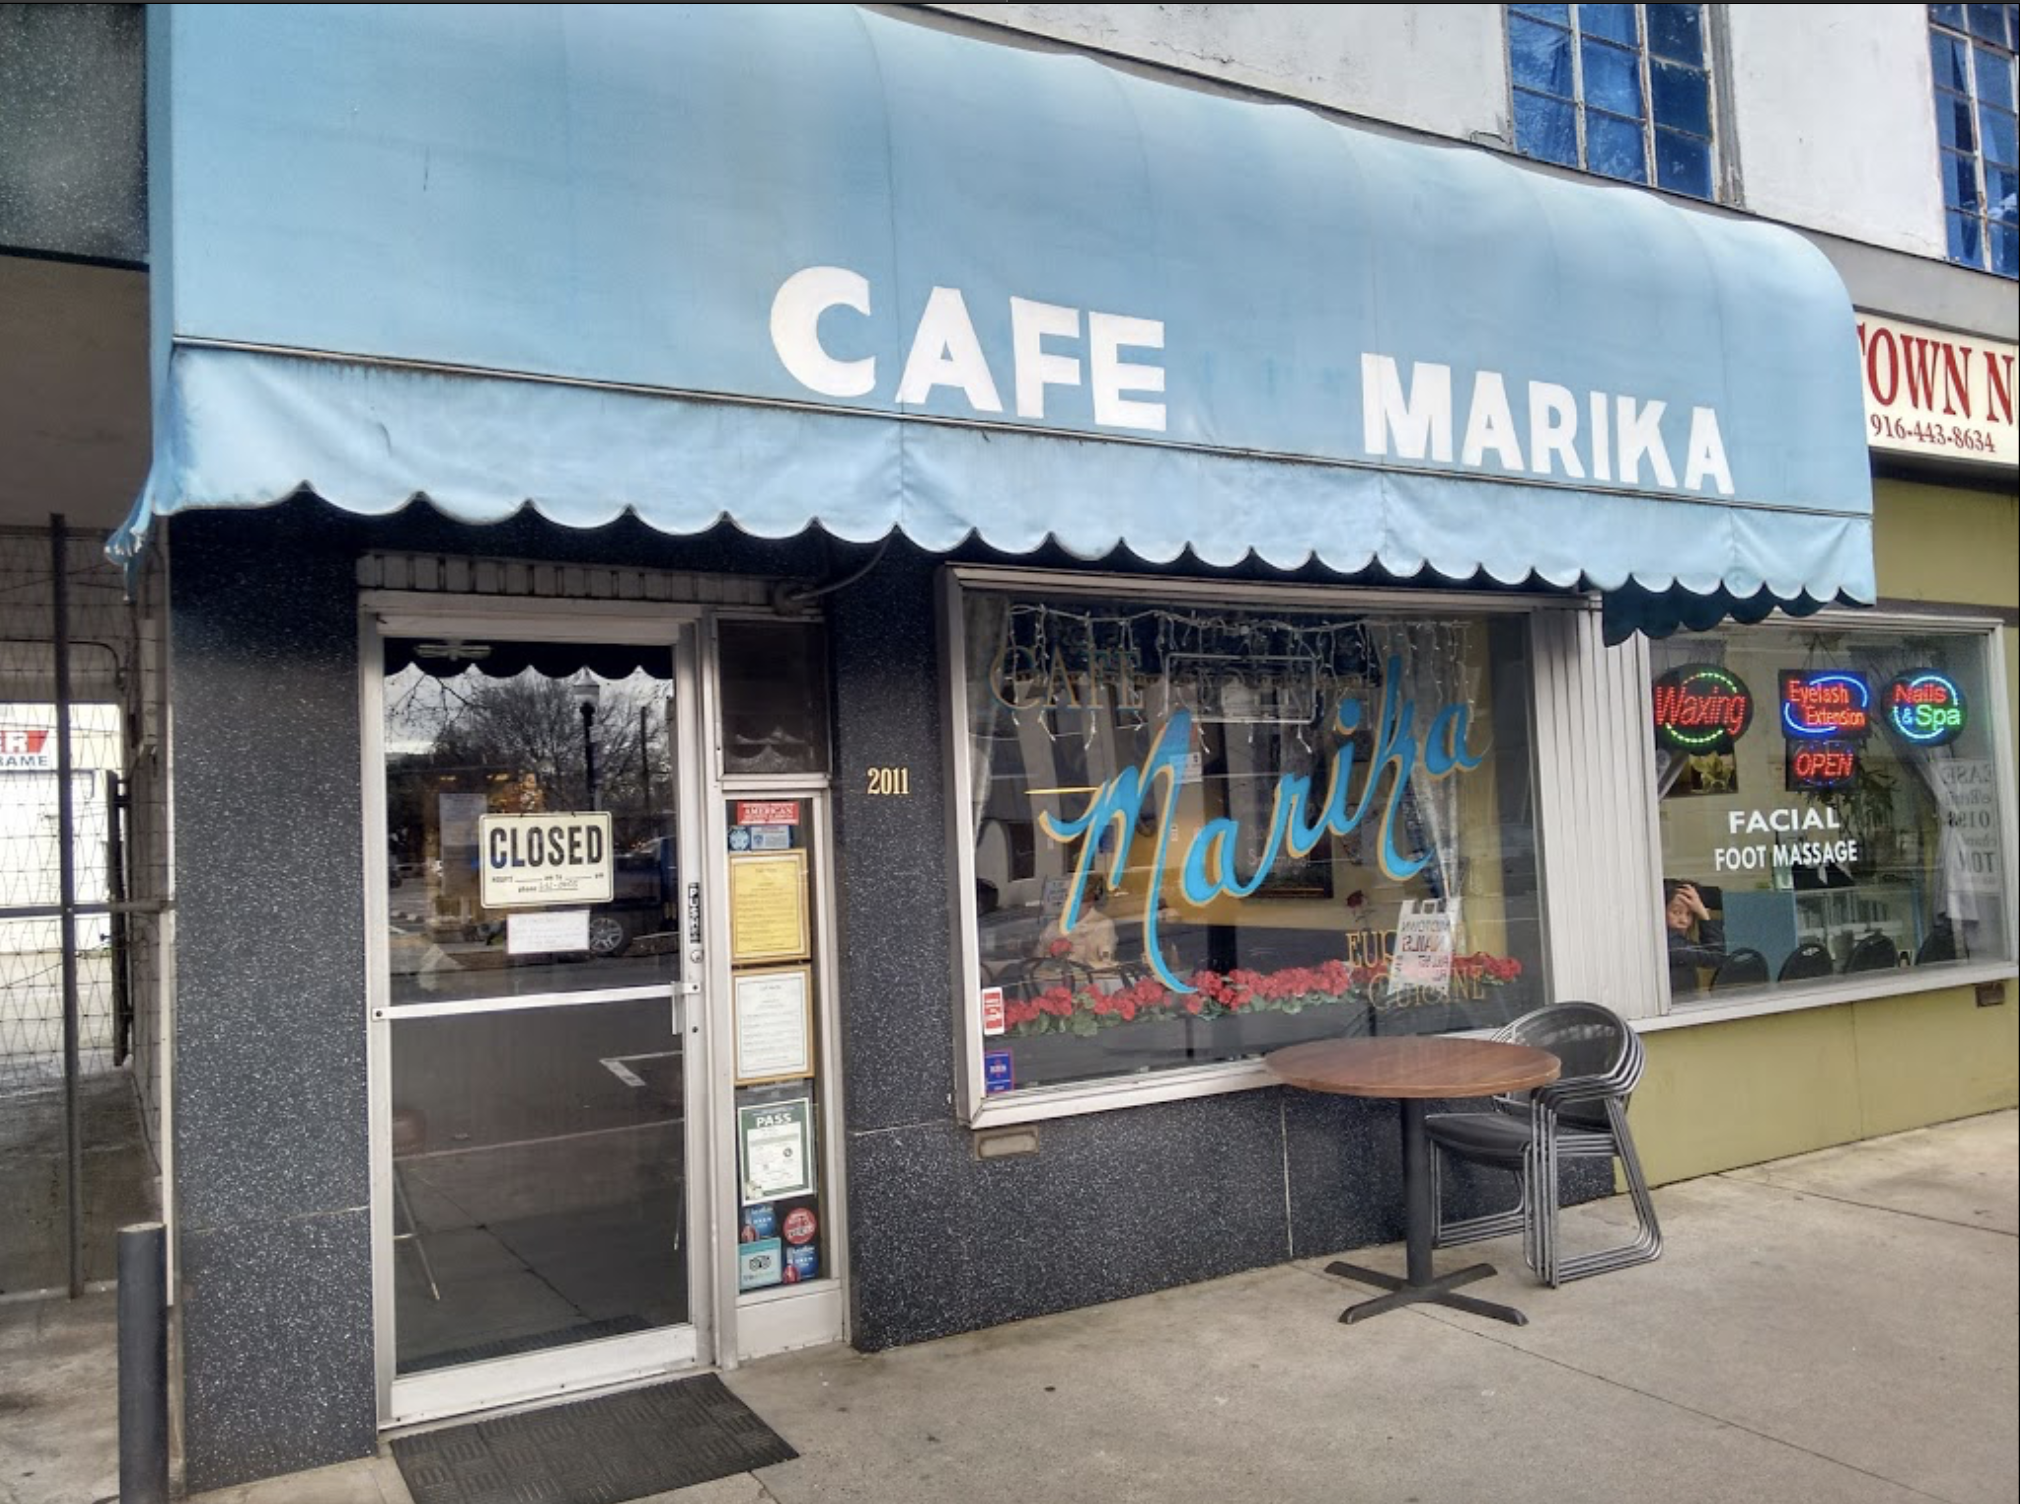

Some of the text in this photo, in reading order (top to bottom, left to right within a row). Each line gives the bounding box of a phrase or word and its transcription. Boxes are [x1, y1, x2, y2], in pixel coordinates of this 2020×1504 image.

[770, 266, 1735, 495] CAFE MARIKA
[1857, 322, 1972, 420] OWN
[990, 645, 1145, 709] CAFE
[1789, 680, 1849, 706] Eyelash
[1895, 684, 1947, 704] Nails
[1655, 686, 1746, 735] Waxing
[1805, 706, 1866, 727] Extension
[1902, 704, 1961, 731] & Spa
[1795, 753, 1853, 777] OPEN
[867, 767, 910, 795] 2011
[1039, 655, 1482, 993] Marika
[1728, 807, 1840, 834] FACIAL
[490, 824, 602, 869] CLOSED
[1714, 840, 1858, 872] FOOT MASSAGE
[756, 1113, 792, 1127] PASS
